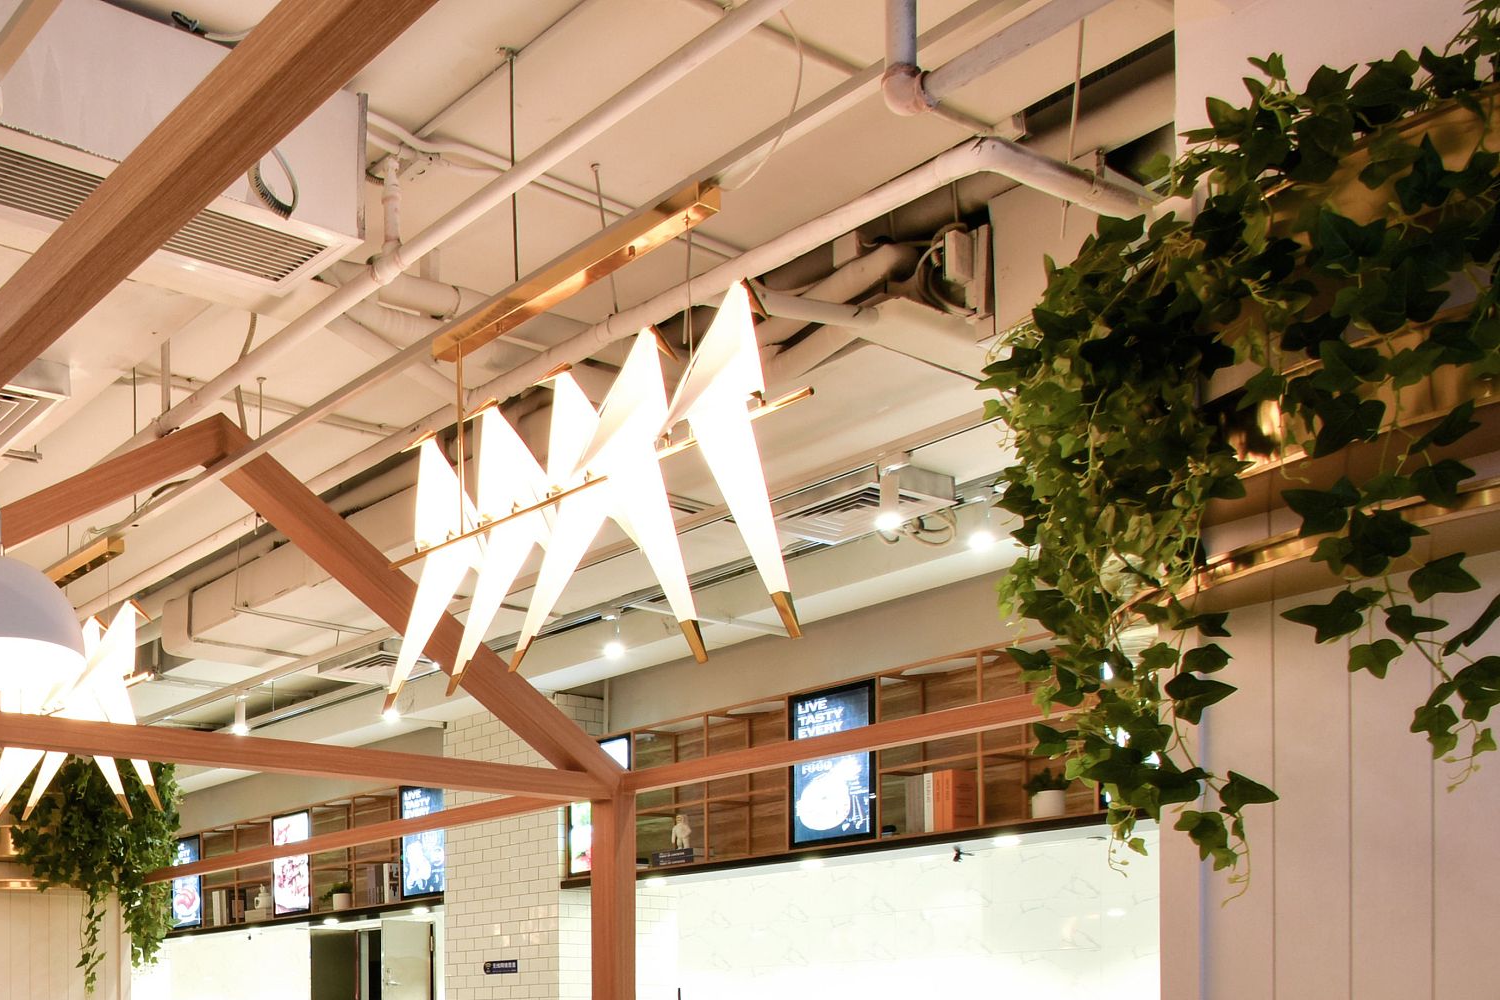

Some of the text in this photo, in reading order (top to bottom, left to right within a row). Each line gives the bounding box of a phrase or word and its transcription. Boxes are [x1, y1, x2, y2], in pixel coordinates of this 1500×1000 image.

[798, 699, 827, 714] LIVE
[798, 707, 844, 726] TASTY
[798, 720, 843, 739] EVERY
